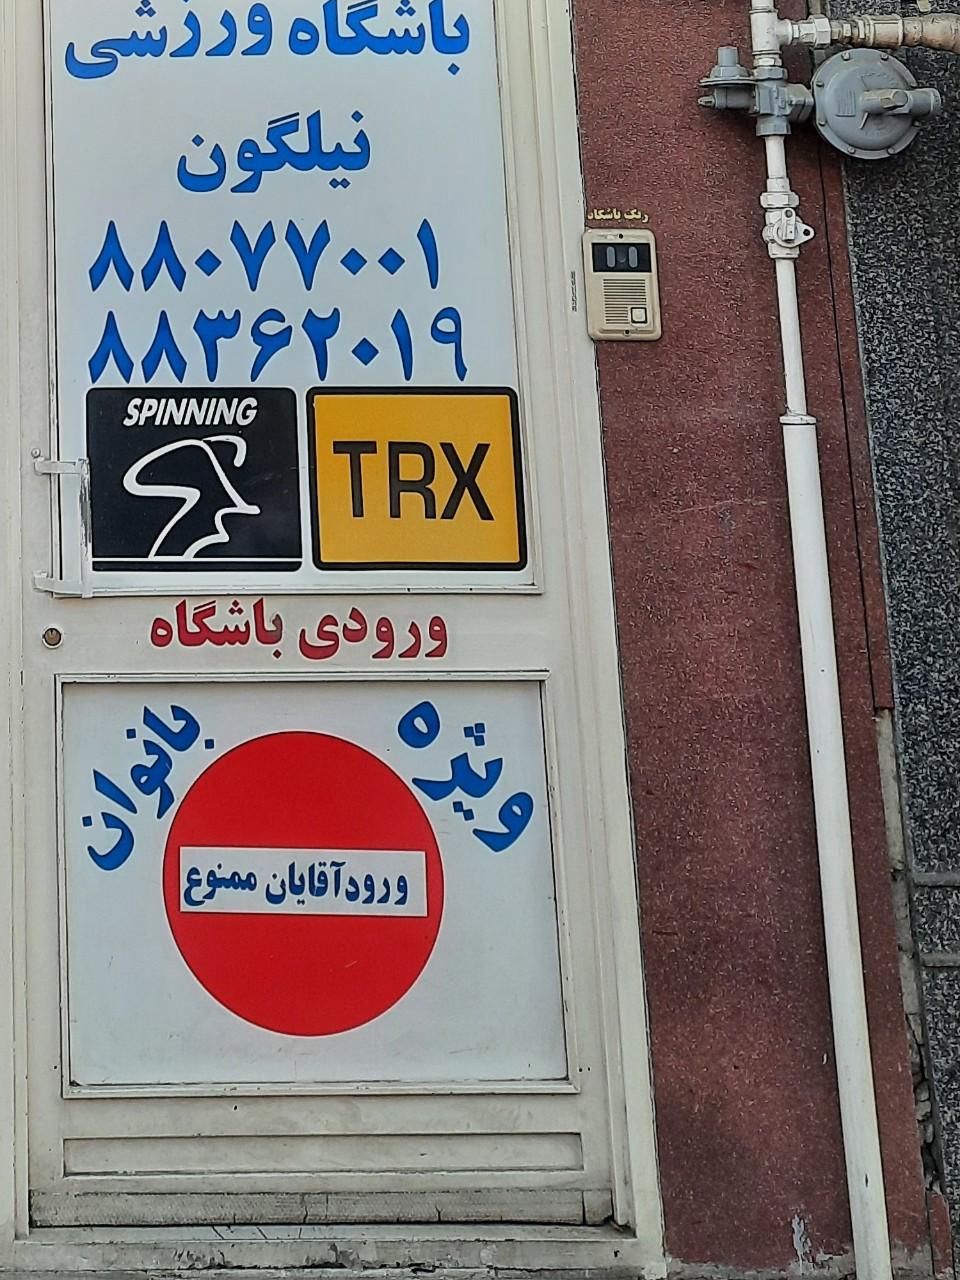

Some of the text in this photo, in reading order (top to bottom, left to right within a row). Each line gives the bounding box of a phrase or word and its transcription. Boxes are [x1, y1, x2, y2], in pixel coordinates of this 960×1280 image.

[177, 110, 371, 193] نیلگون
[88, 218, 439, 292] ۸۸۰۷۷۰۰۱
[88, 306, 467, 383] ۸۸۳۶۲۰۱۹
[123, 397, 258, 426] SPINNING
[332, 440, 494, 520] TRX
[150, 597, 448, 660] ورودی باشگاه
[82, 701, 534, 871] ویژه بانوان
[183, 864, 258, 906] ممنوع
